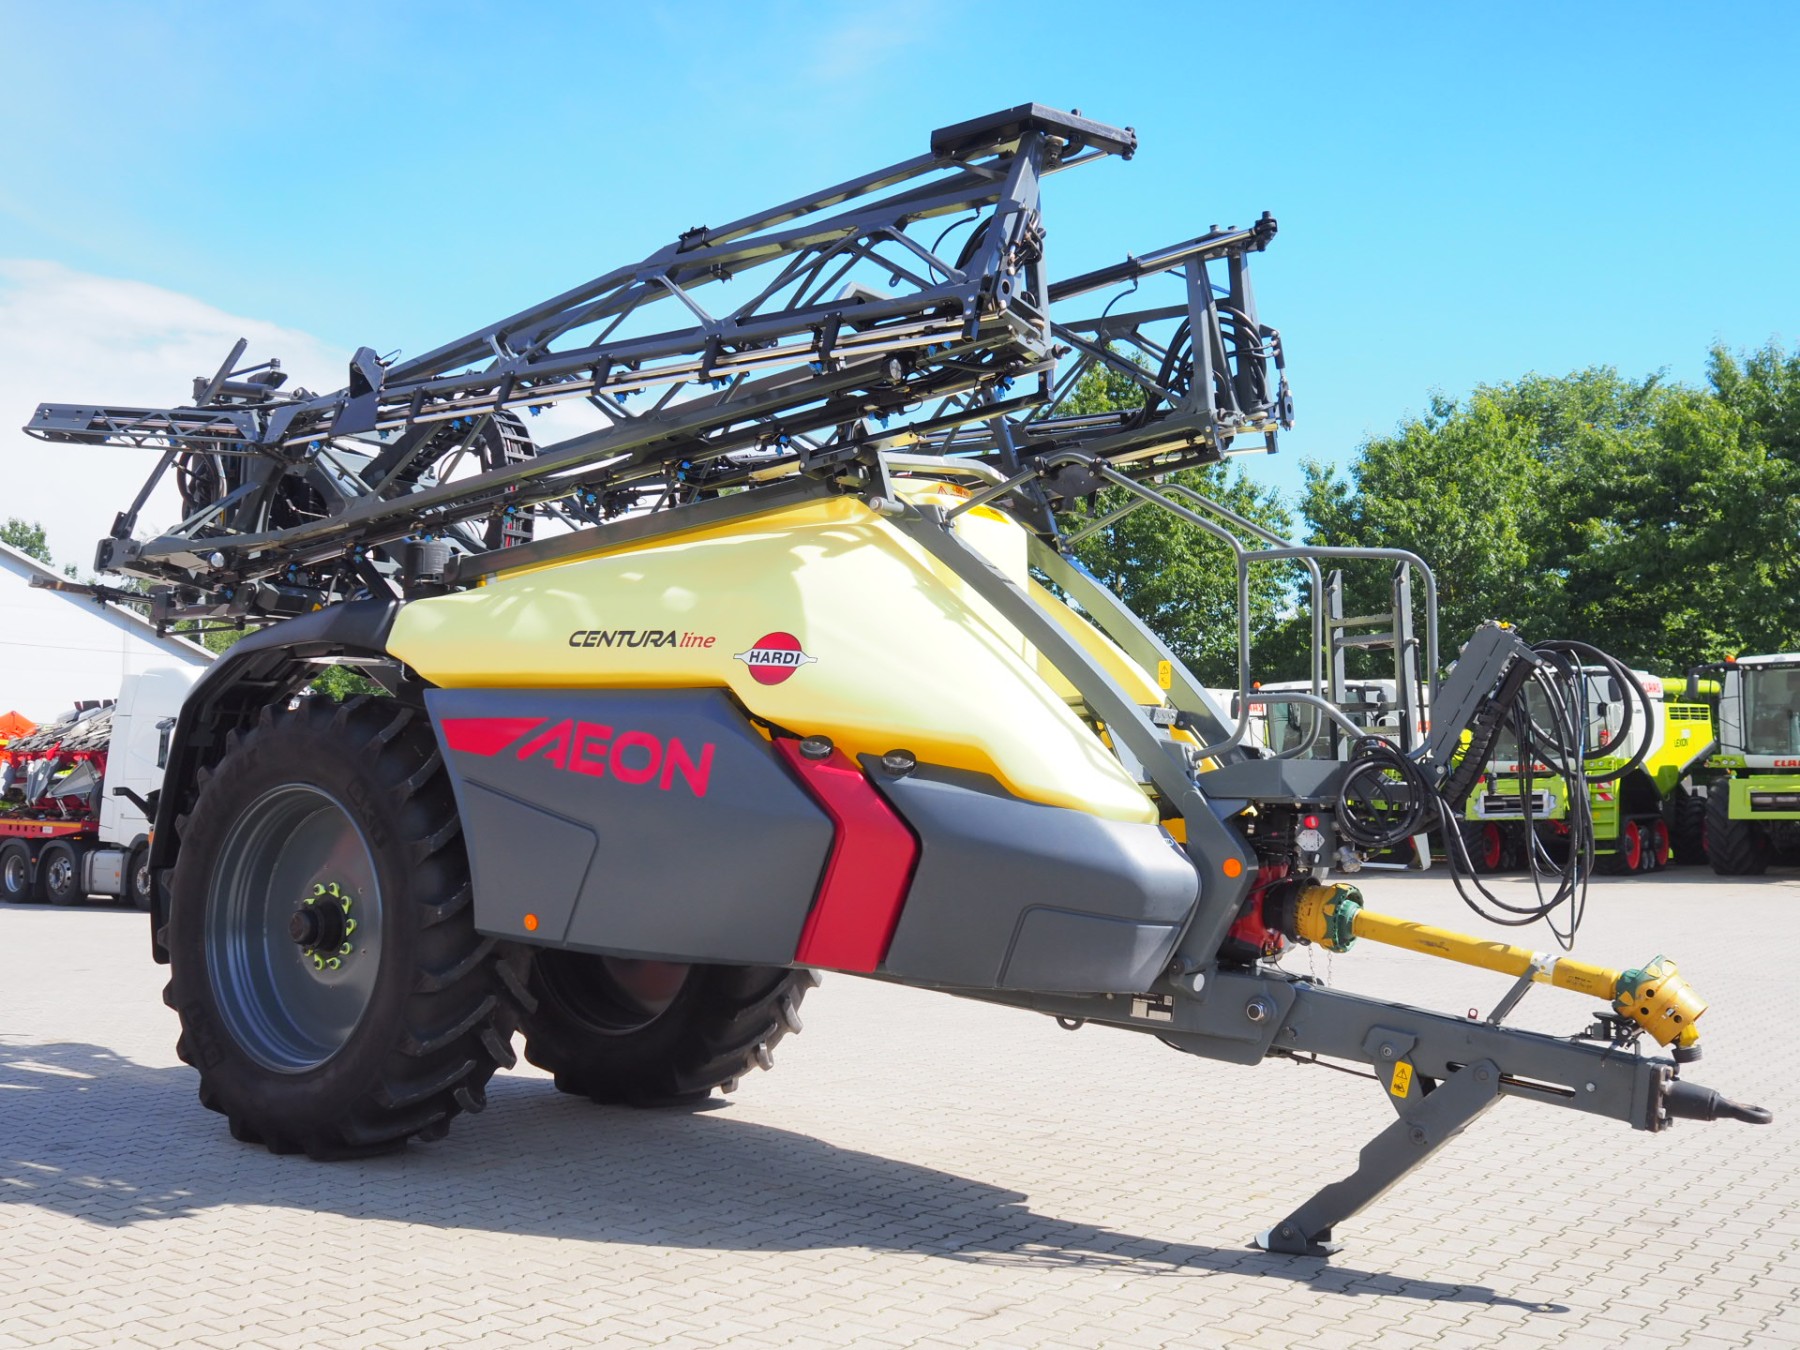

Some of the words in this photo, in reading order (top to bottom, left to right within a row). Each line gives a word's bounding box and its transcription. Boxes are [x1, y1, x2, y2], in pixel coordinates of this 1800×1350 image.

[569, 630, 677, 648] CENTURA
[679, 631, 716, 648] line
[748, 650, 800, 666] HARDI
[516, 717, 716, 798] AEON
[1773, 759, 1800, 767] CLA
